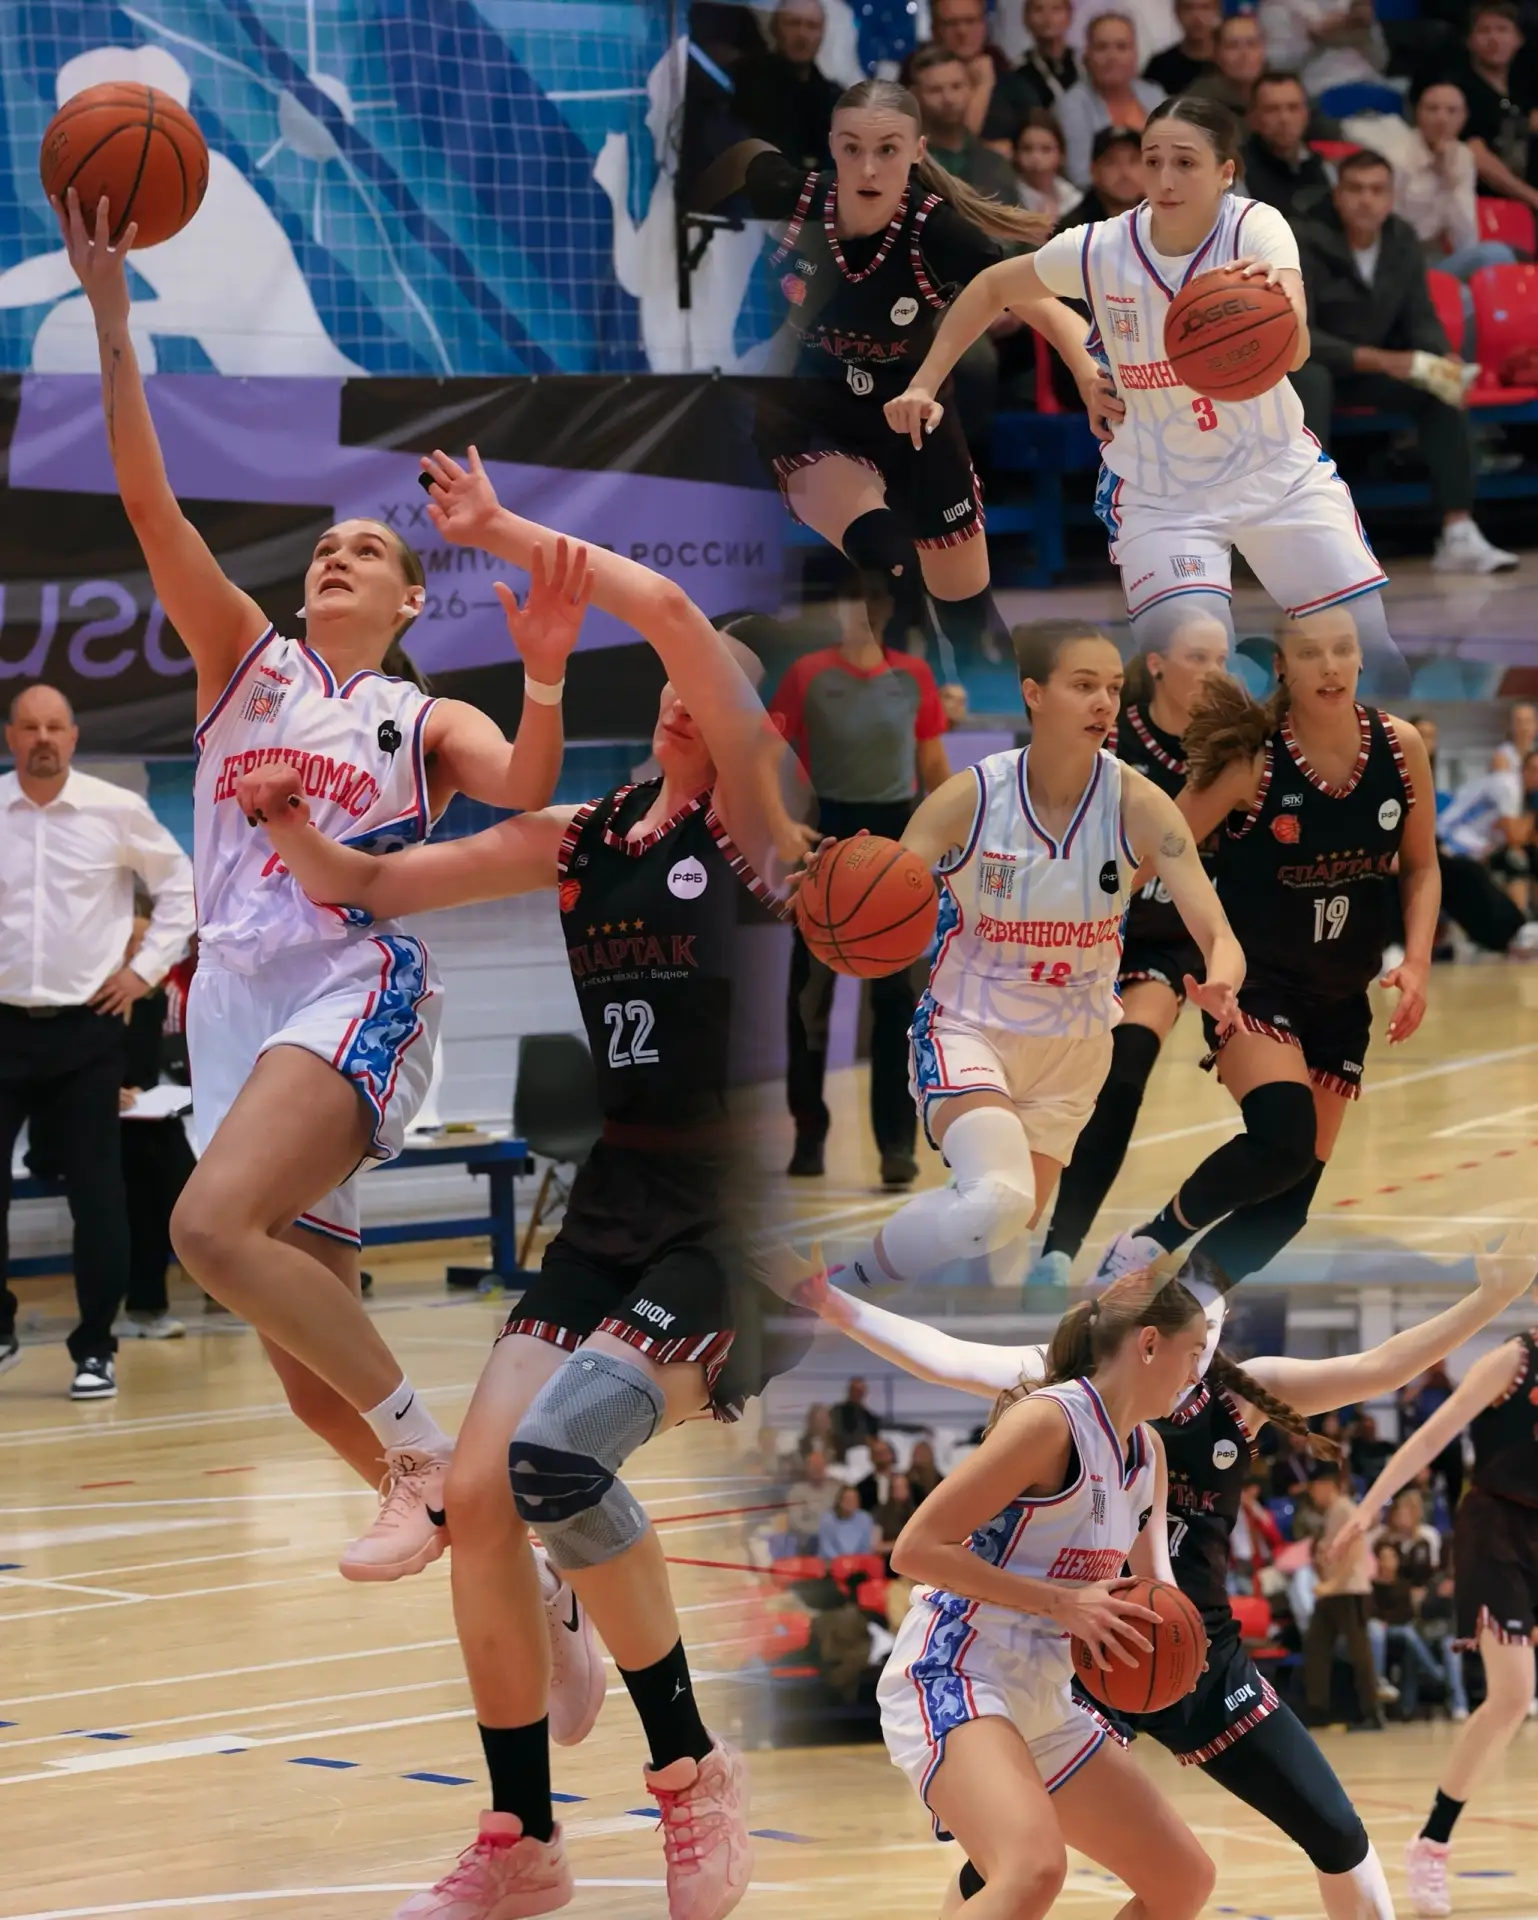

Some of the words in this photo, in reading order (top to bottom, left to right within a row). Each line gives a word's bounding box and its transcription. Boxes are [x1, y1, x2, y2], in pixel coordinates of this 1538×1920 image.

[1105, 294, 1136, 304] MAXX
[1191, 396, 1218, 432] 3
[943, 497, 973, 523] ШФК
[1284, 796, 1302, 805] STK
[982, 851, 1017, 862] MAXX
[672, 873, 703, 884] РФБ
[1101, 874, 1118, 882] РФ
[974, 913, 1124, 949] НЕВИННОМЫСС
[1313, 895, 1350, 943] 19
[569, 935, 699, 978] ПАРТАК
[651, 968, 689, 980] Видное
[603, 999, 660, 1068] 22
[631, 1298, 677, 1331] ШФК
[1216, 1450, 1236, 1459] РФБ
[1224, 1682, 1257, 1712] ШФК
